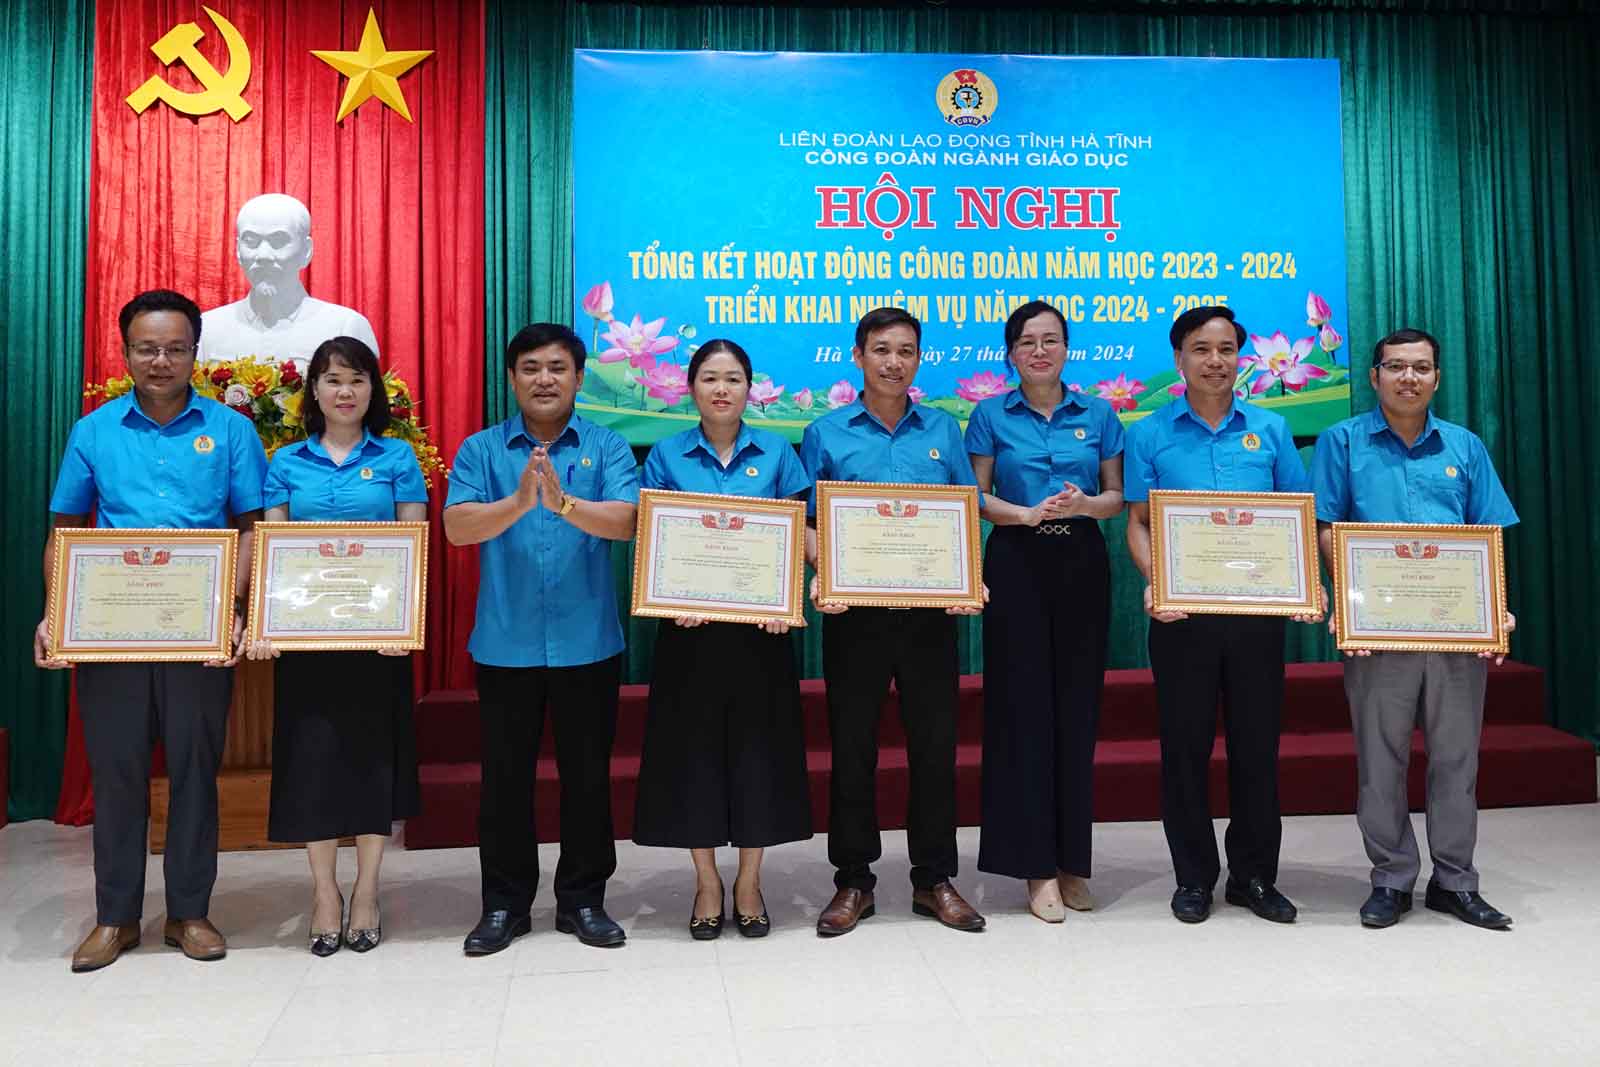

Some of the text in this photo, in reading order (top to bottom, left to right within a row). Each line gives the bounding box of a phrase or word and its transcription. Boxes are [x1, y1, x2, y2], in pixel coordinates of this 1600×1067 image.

[779, 130, 826, 147] LIÊN
[832, 131, 893, 147] ĐOÀN
[900, 134, 942, 147] LAO
[1071, 132, 1099, 148] HÀ
[1104, 133, 1152, 149] TĨNH
[805, 149, 1128, 169] CÔNG ĐOÀN NGÀNH GIÁO DỤC
[815, 171, 1120, 242] HỘI NGHỊ
[628, 240, 695, 279] TỔNG
[702, 242, 747, 279] KẾT
[755, 251, 818, 286] HOẠT
[824, 245, 891, 286] ĐỘNG
[899, 246, 966, 280] CÔNG
[972, 245, 1038, 279] ĐOÀN
[1045, 245, 1100, 279] NĂM
[1108, 251, 1155, 285] HỌC
[1161, 251, 1218, 279] 2023
[1241, 252, 1297, 279] 2024
[704, 284, 776, 324] TRIỂN
[784, 295, 841, 324] KHAI
[936, 295, 967, 328] VỤ
[1092, 295, 1149, 323] 2024
[814, 346, 842, 363] Hà
[950, 345, 972, 361] 27
[1092, 345, 1136, 361] 2024
